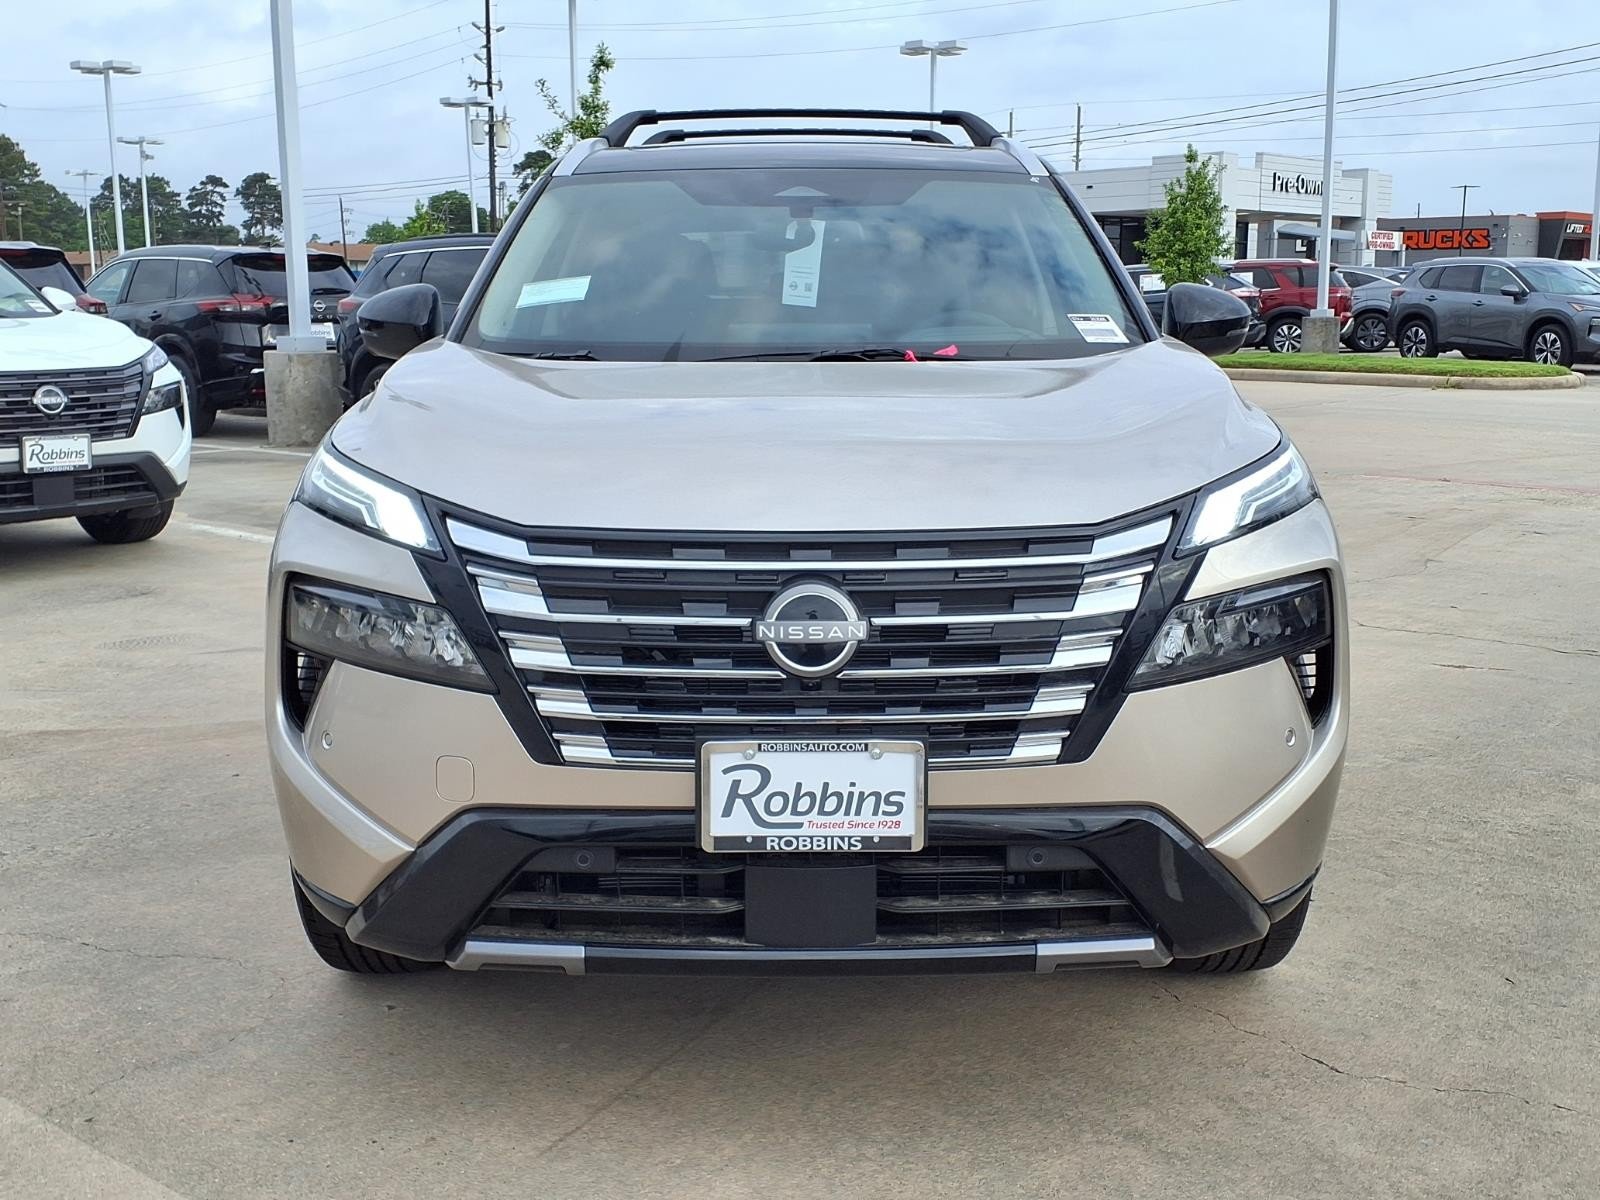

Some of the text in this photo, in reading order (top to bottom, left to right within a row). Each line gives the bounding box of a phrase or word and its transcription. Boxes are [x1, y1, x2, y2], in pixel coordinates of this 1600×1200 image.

[1272, 171, 1323, 196] Pre-Own
[1371, 231, 1394, 240] CERTIFIED
[1402, 229, 1489, 249] RUCKS
[1369, 240, 1395, 249] PRE-OWNED
[28, 443, 86, 464] Robbins
[44, 465, 74, 473] ROBBINS
[759, 625, 864, 639] NISSAN
[760, 743, 866, 752] ROBBINSAUTO.COM
[720, 763, 906, 829] Robbins
[806, 820, 901, 829] Trusted Since 1928
[766, 836, 862, 850] ROBBINS
